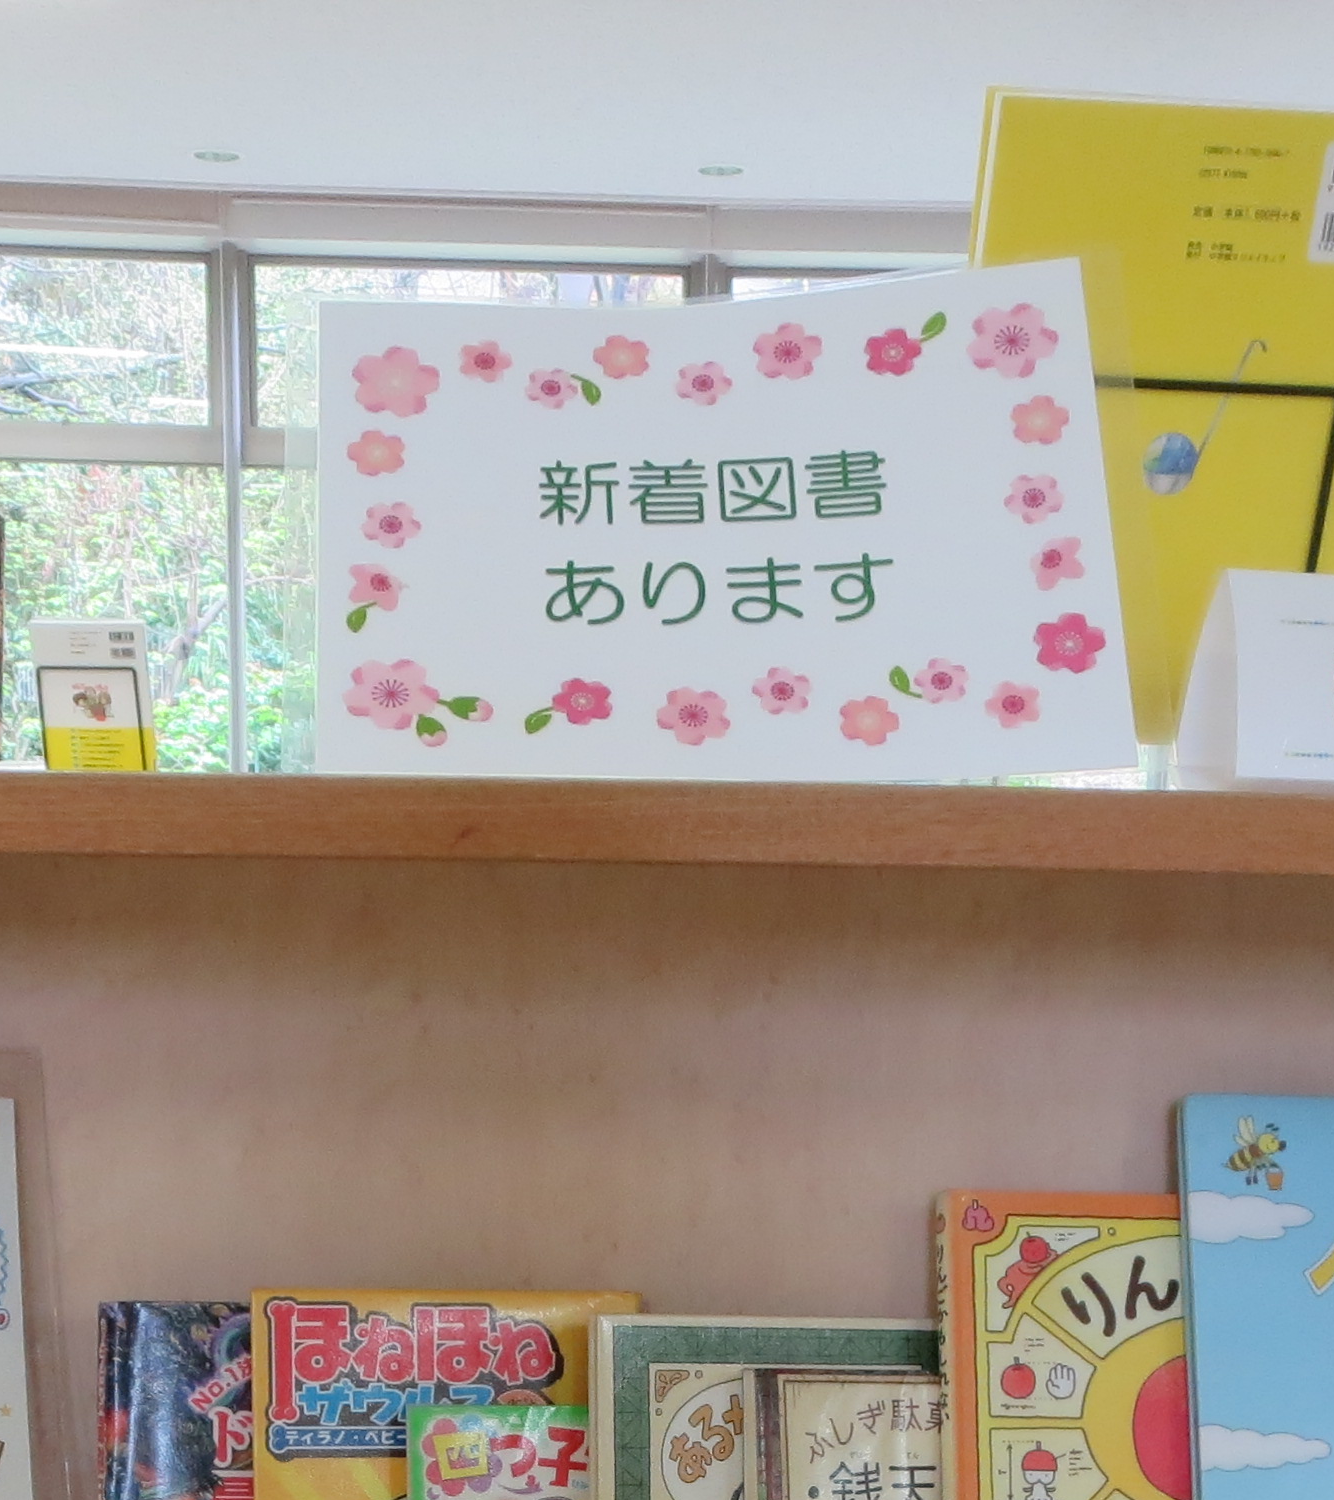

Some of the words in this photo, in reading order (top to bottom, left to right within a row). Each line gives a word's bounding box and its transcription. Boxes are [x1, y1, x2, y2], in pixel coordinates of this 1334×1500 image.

[538, 450, 887, 527] 新着図書
[544, 552, 894, 626] あります
[1061, 1255, 1180, 1338] りん
[269, 1302, 557, 1390] ほねほね
